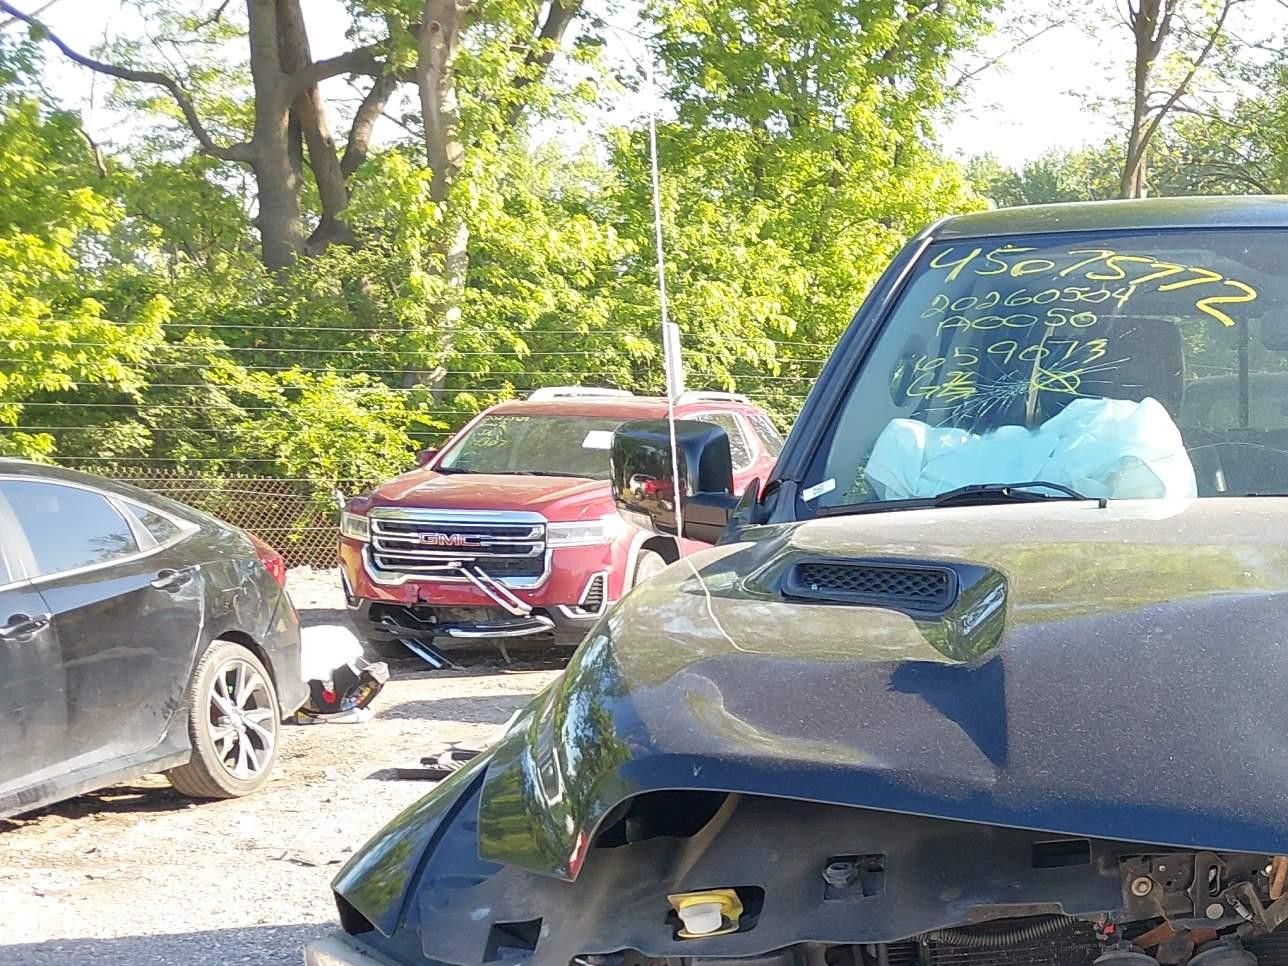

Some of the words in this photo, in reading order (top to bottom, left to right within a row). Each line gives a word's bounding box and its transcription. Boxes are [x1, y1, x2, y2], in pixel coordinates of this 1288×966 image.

[920, 284, 1136, 319] 20260504
[930, 245, 1257, 328] 45075772
[418, 532, 482, 547] GMC
